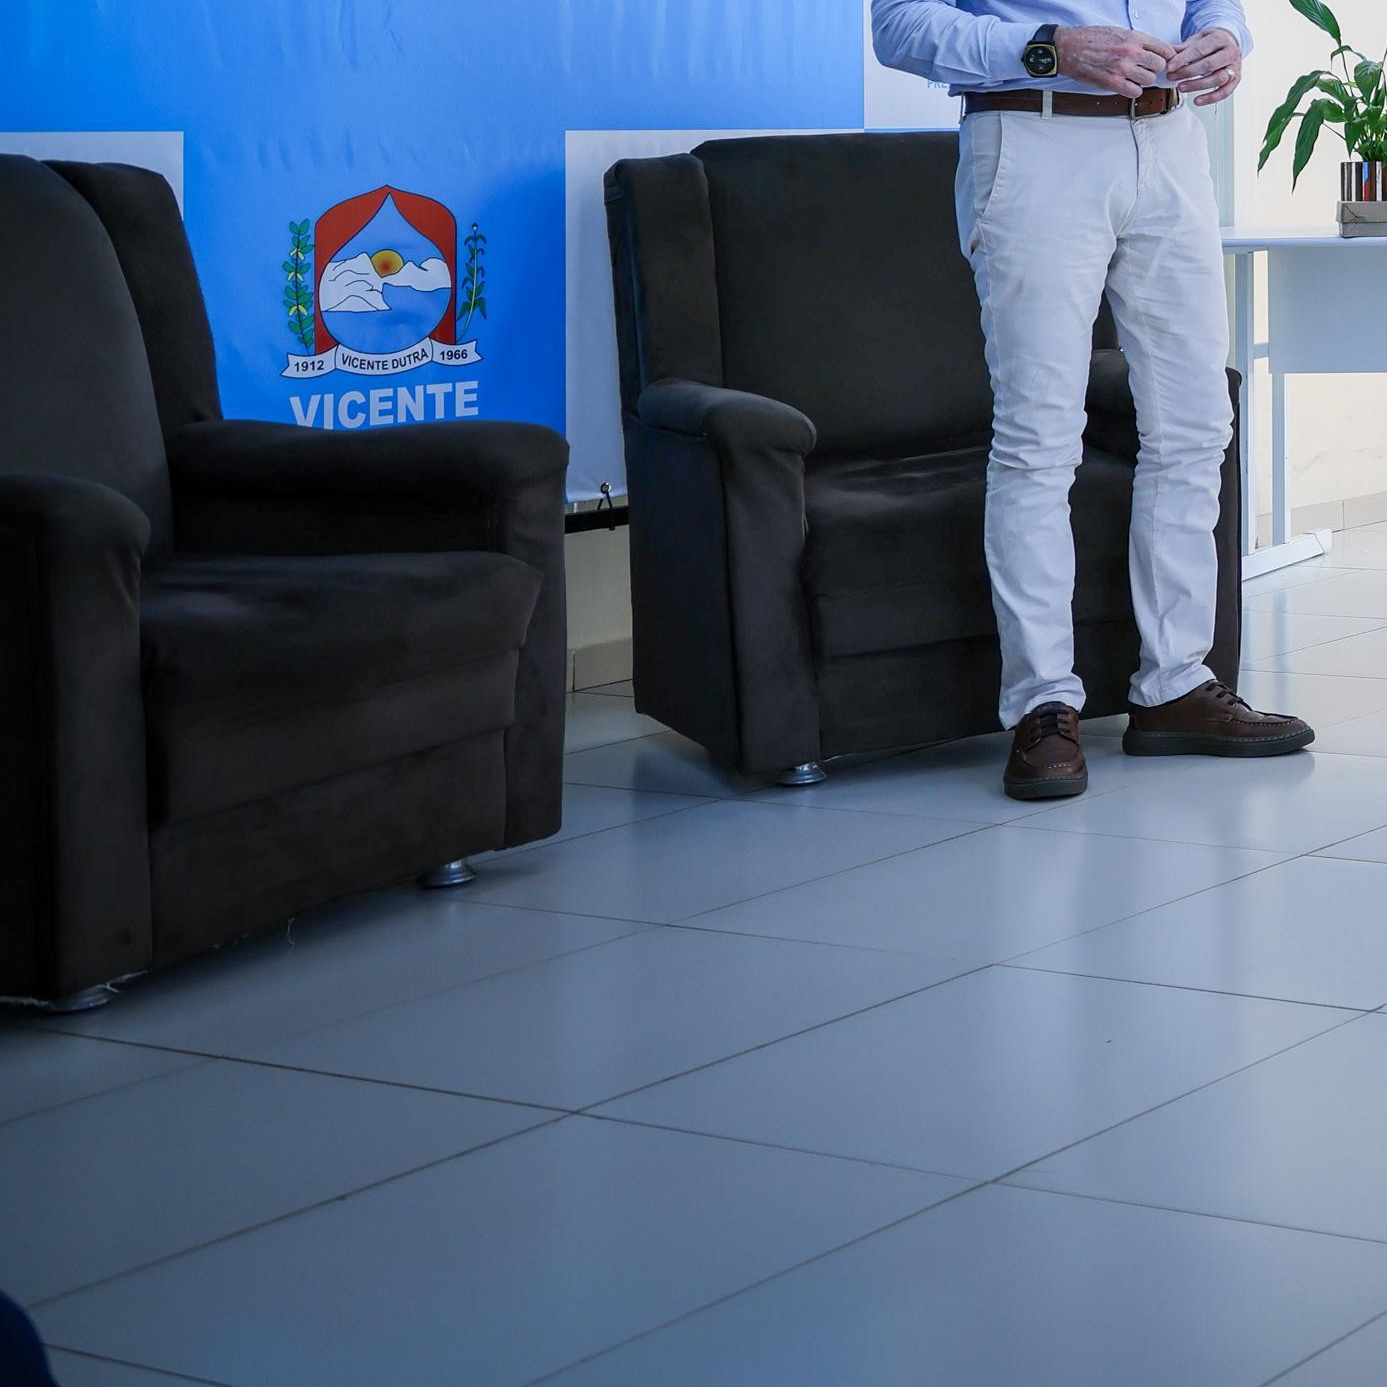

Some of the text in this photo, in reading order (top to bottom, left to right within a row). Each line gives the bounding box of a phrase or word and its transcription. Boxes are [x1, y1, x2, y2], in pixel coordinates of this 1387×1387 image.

[341, 348, 429, 371] VICENTE DUTRA
[439, 349, 468, 361] 1966
[294, 359, 324, 372] 1912
[289, 380, 479, 430] VICENTE
